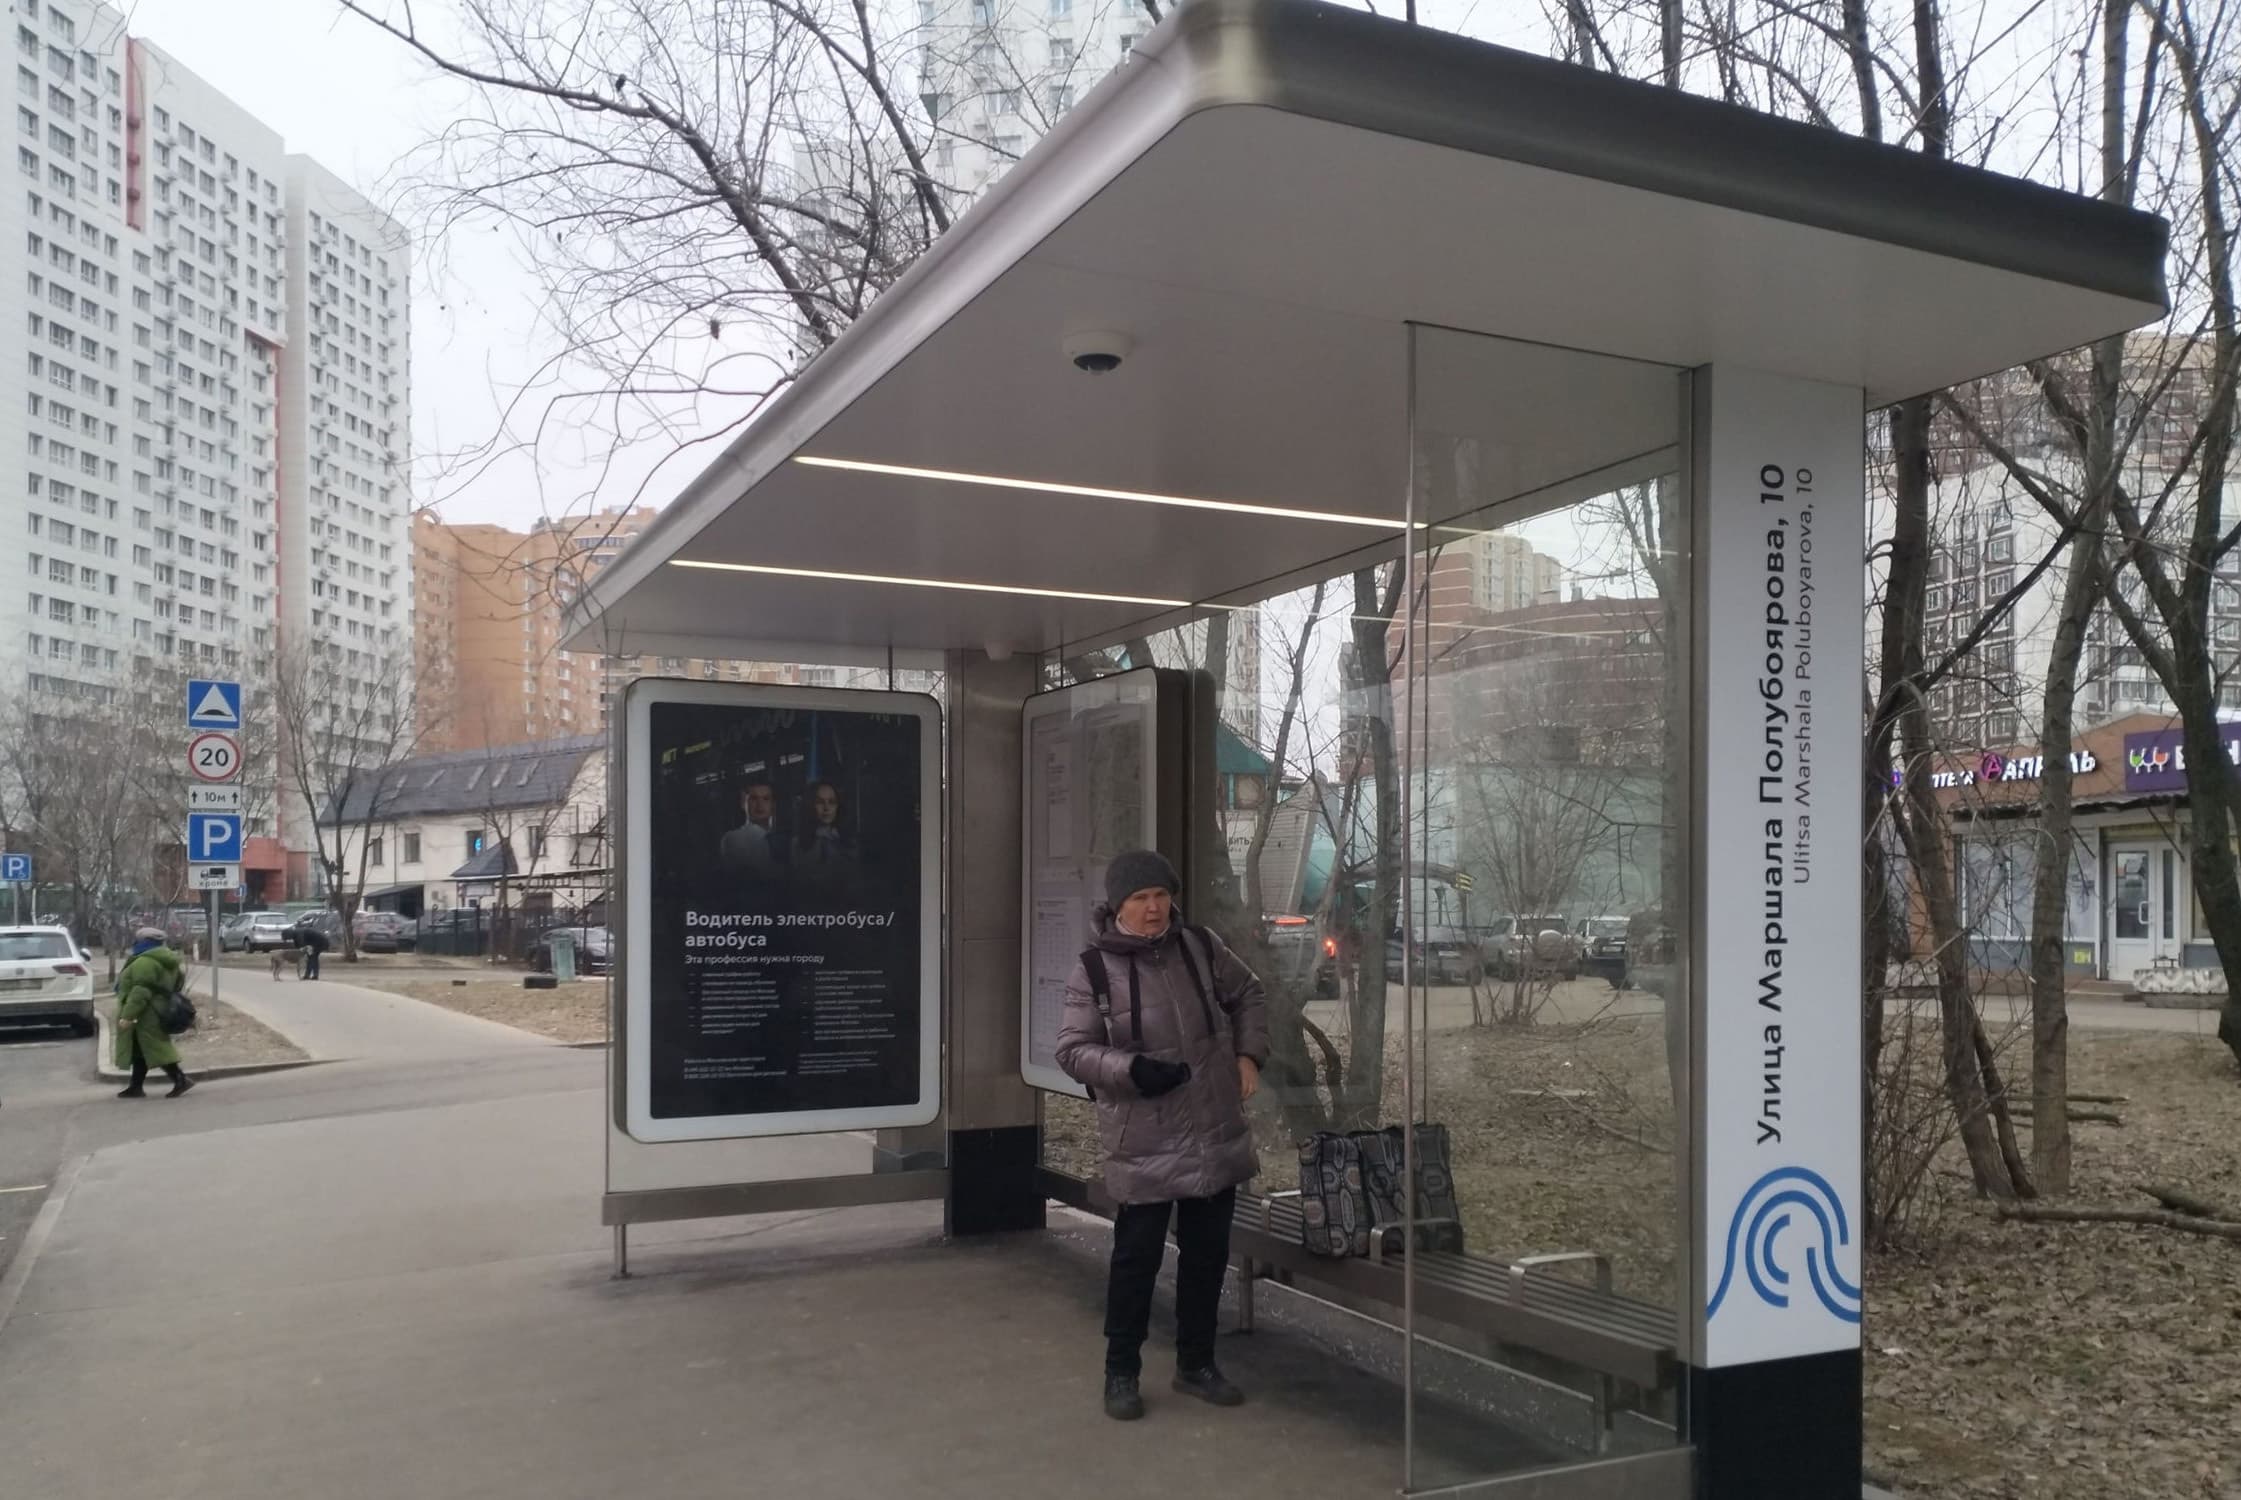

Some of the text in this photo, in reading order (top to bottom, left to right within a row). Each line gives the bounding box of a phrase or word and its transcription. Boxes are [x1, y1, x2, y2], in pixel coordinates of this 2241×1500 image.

[1794, 467, 1815, 884] Ulitsa Marshala Poluboyarova, 10
[199, 747, 229, 767] 20
[1757, 463, 1789, 1145] Улица Маршала Полубоярова, 10
[203, 819, 232, 857] P
[8, 857, 25, 878] P
[685, 911, 895, 929] Водитель электробуса/
[685, 931, 767, 950] автобуса
[684, 953, 825, 966] Эта профессия нужна городу
